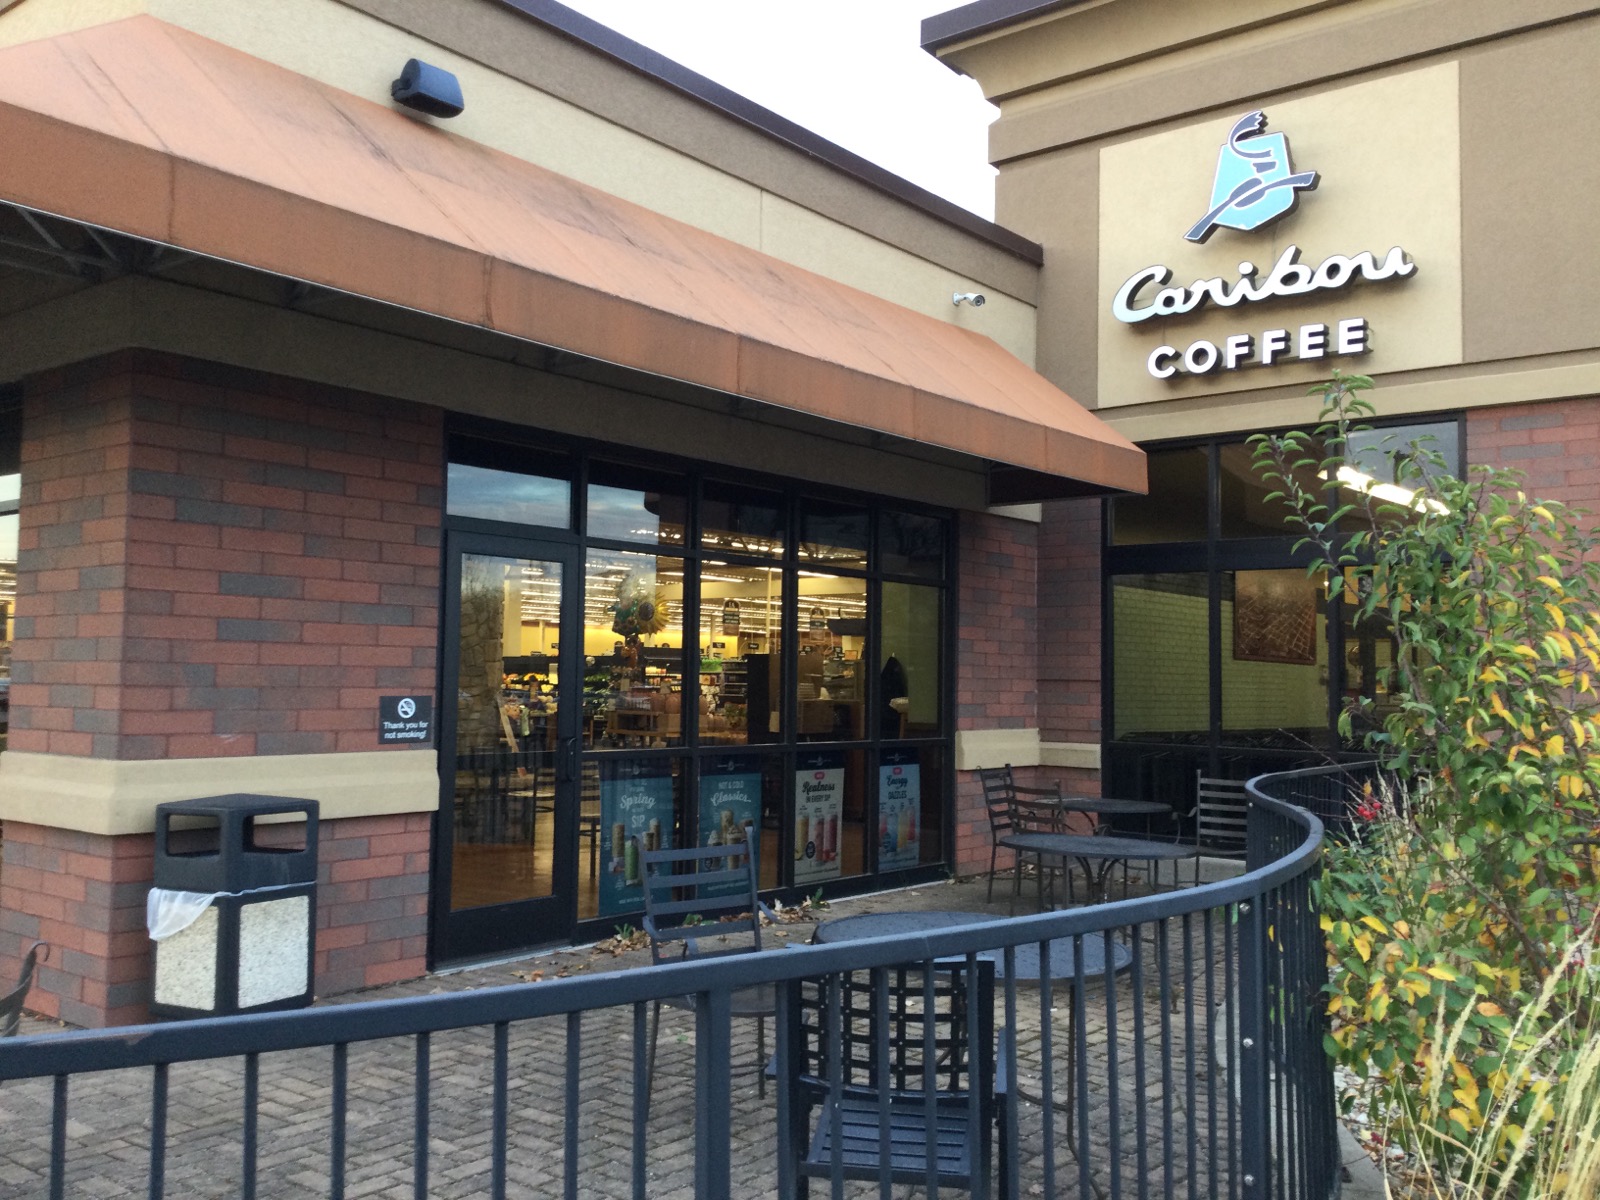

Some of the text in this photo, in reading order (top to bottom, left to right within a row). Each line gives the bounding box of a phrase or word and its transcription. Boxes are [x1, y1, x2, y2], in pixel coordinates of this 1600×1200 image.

[1113, 244, 1416, 323] Caribou
[1147, 318, 1367, 379] COFFEE
[383, 721, 404, 729] Thank
[405, 722, 418, 730] you
[397, 730, 426, 739] smoking!
[802, 780, 835, 795] Realness
[620, 793, 656, 811] Spring
[710, 791, 751, 806] Classics
[632, 815, 646, 829] SIP
